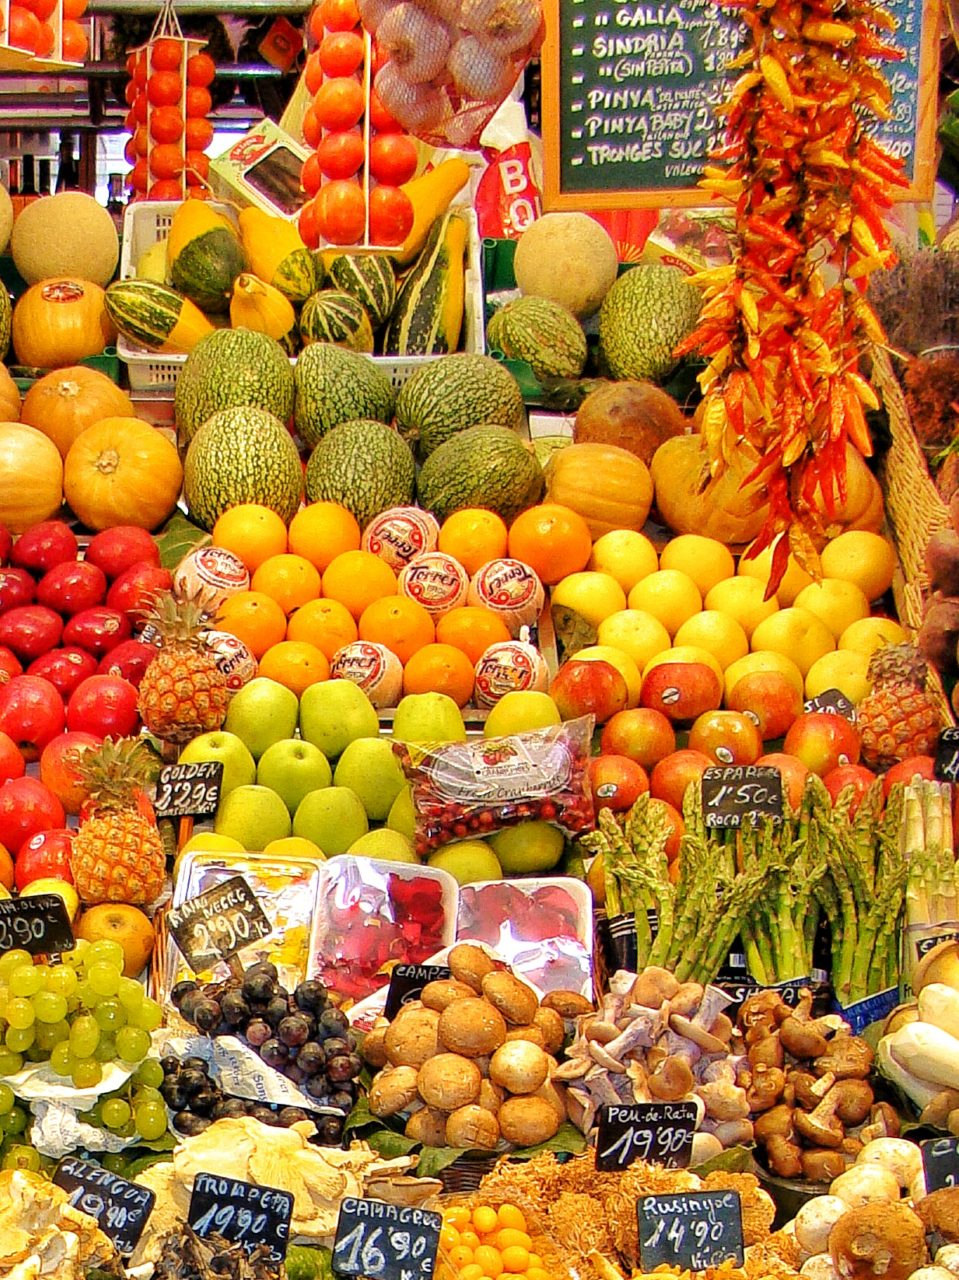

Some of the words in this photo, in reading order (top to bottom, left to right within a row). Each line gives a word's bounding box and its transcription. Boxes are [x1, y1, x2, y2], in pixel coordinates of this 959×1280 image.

[587, 88, 654, 111] PINYA
[585, 116, 648, 137] PINYA
[410, 565, 460, 587] Torres
[161, 763, 219, 784] GOLDEN
[643, 1217, 724, 1253] 14'90
[334, 1222, 427, 1276] 16'90
